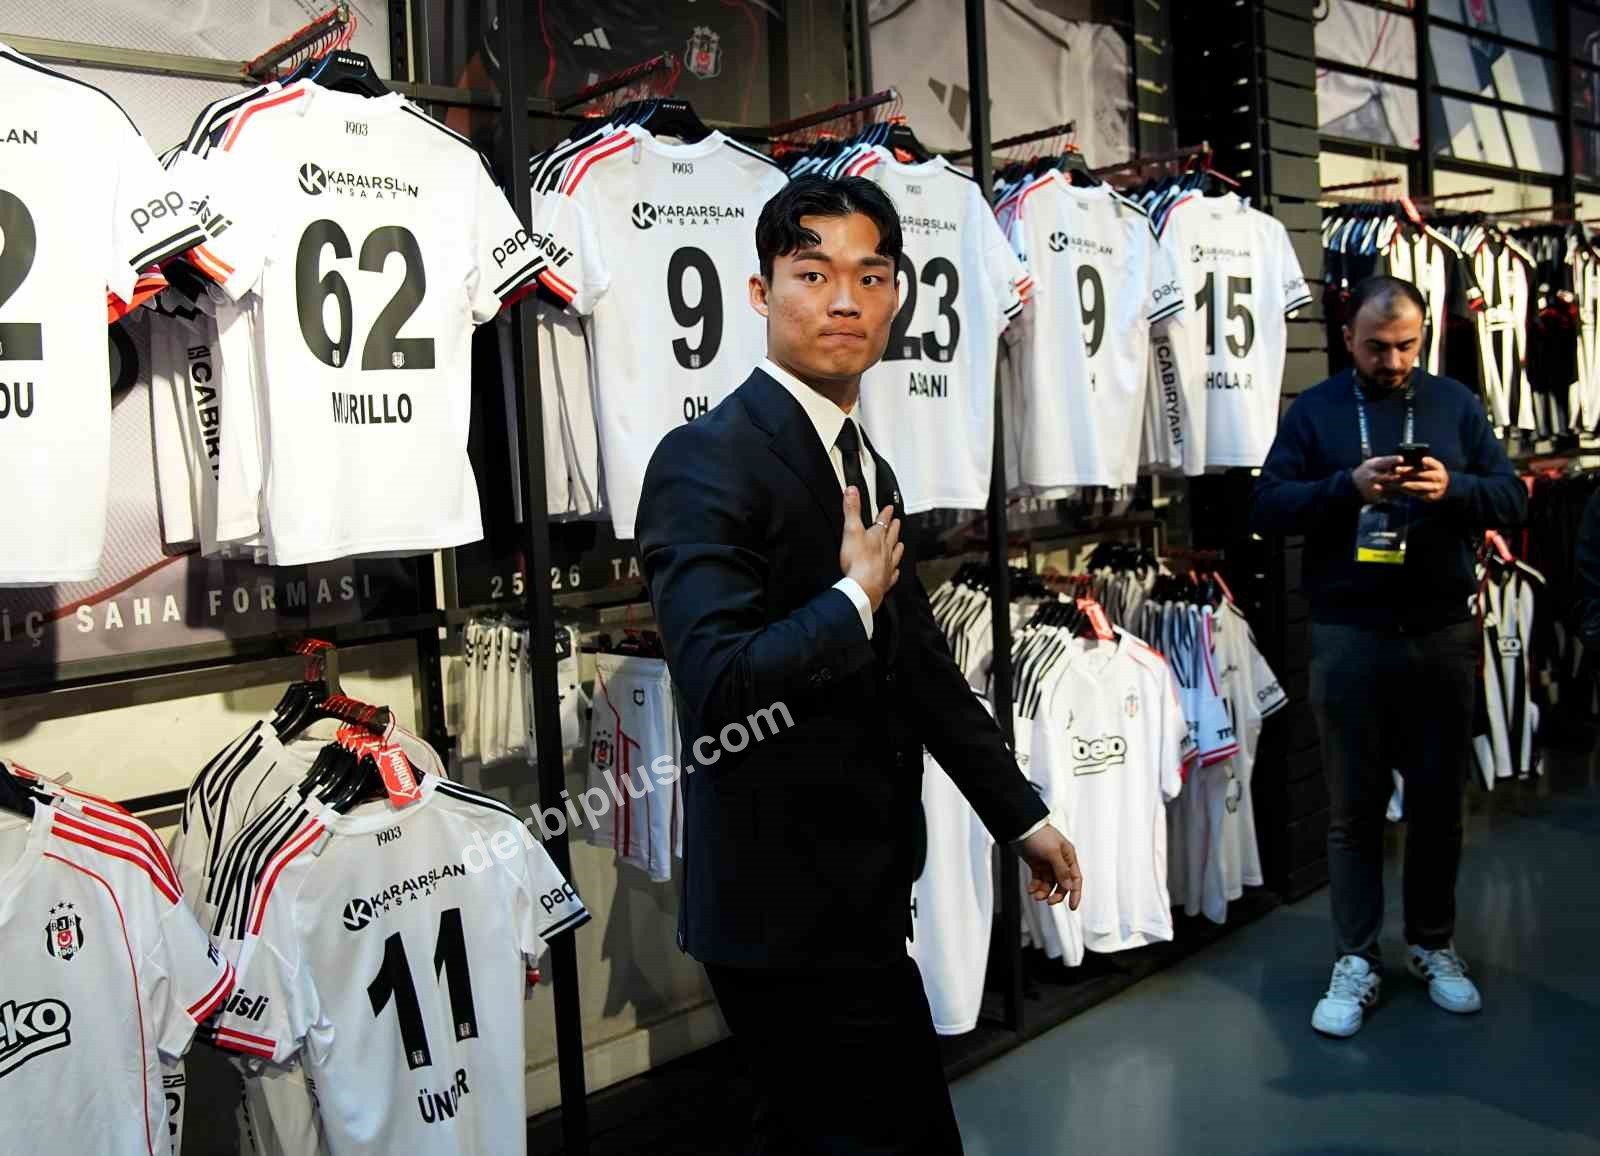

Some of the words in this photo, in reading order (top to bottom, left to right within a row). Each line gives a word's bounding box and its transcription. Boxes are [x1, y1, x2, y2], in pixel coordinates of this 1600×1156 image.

[0, 128, 38, 144] AN
[344, 120, 369, 137] 1903
[672, 161, 694, 175] 1903
[295, 218, 436, 371] 62
[666, 246, 724, 370] 9
[880, 256, 961, 363] 23
[1076, 264, 1106, 358] 9
[1193, 272, 1256, 359] 15
[331, 391, 413, 425] MURILLO
[683, 395, 709, 423] OH
[75, 594, 182, 634] SAHA
[208, 573, 371, 616] FORMASI
[1071, 733, 1128, 762] beo
[376, 826, 402, 847] 1903
[223, 988, 270, 1021] isli
[367, 907, 479, 1071] 11
[0, 998, 72, 1048] ko
